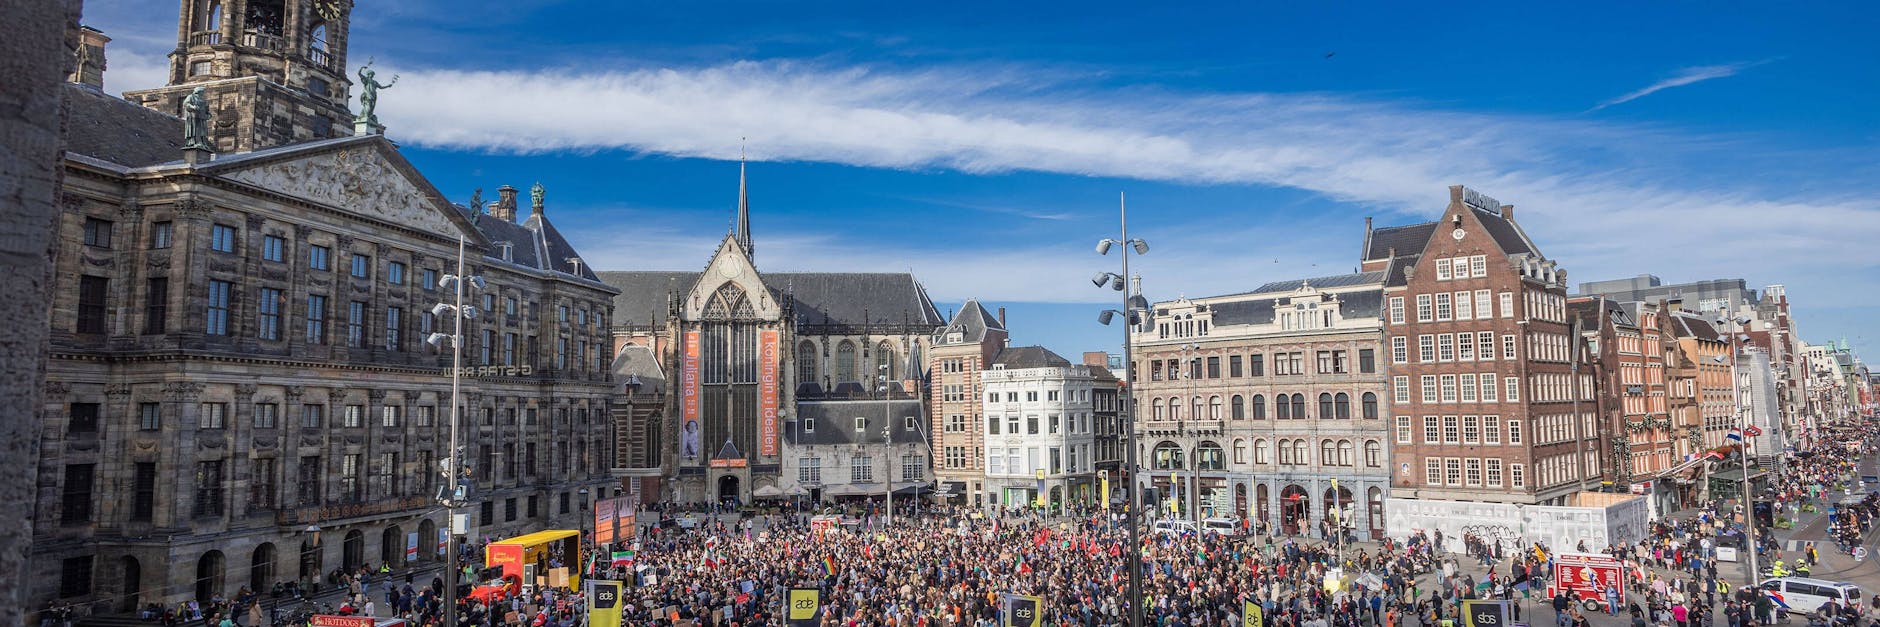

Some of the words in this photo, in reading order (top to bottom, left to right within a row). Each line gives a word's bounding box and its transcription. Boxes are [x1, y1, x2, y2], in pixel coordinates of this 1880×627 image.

[685, 352, 698, 396] Juliana
[763, 342, 776, 394] koningin
[764, 407, 776, 452] idealen
[599, 590, 614, 600] ade
[795, 596, 814, 609] ade
[1016, 607, 1031, 618] ade
[1247, 611, 1258, 626] ade
